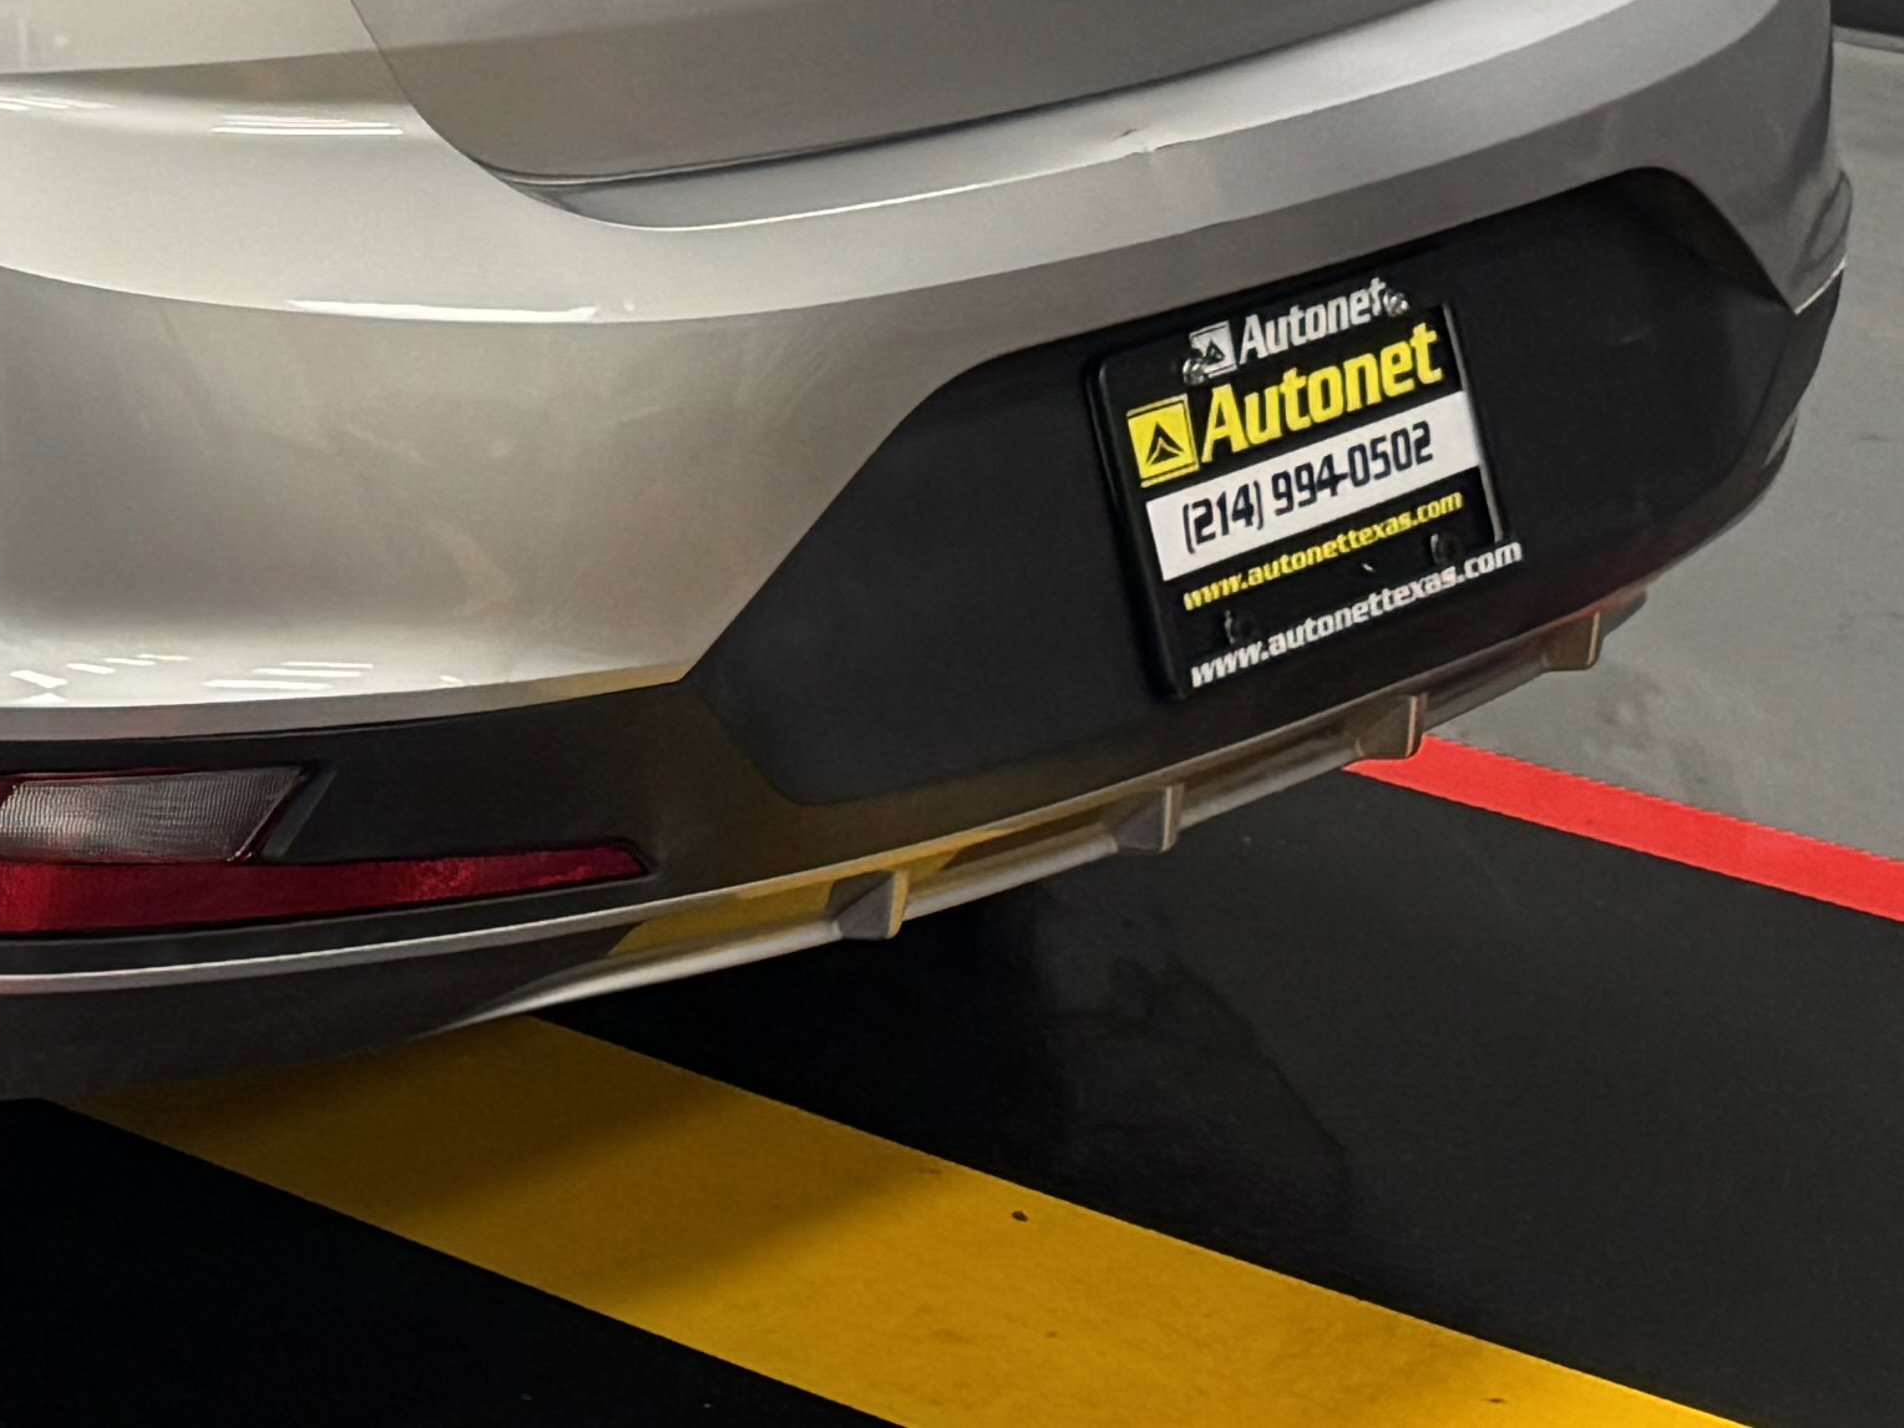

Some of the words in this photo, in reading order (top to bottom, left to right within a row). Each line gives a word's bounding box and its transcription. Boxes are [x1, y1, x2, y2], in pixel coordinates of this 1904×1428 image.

[1238, 276, 1389, 365] Autonet
[1200, 322, 1444, 463] Autonet
[1183, 480, 1263, 554] (214)
[1272, 420, 1433, 515] 994-0502
[1183, 491, 1463, 610] www.autonettexas.com
[1191, 541, 1522, 687] www.autonettexas.com
